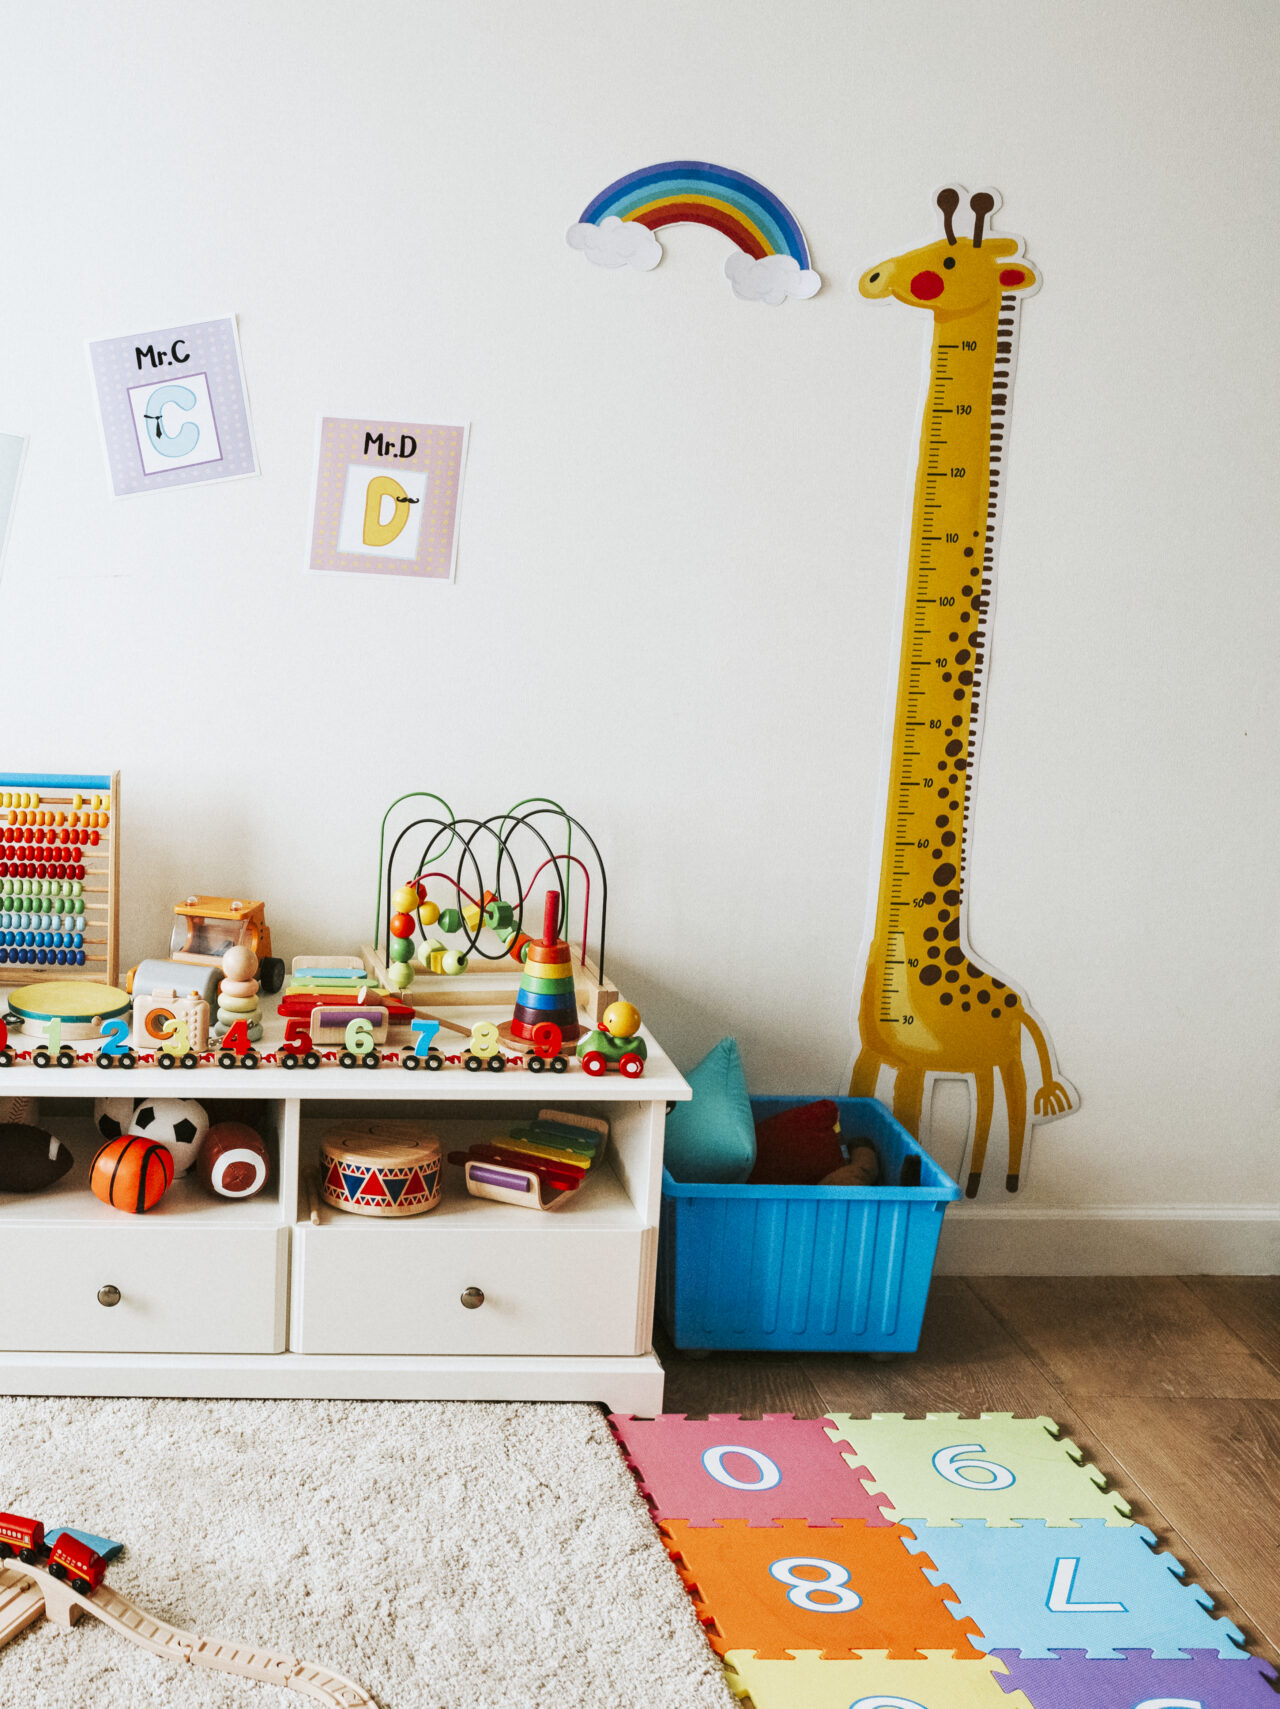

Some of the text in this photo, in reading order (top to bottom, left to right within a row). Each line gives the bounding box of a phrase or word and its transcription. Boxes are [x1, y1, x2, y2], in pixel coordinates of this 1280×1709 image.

[962, 340, 977, 352] 140
[135, 339, 191, 370] Mr.C
[956, 404, 972, 416] 130
[145, 384, 201, 458] C
[363, 431, 417, 459] Mr.D
[950, 467, 966, 478] 120
[362, 475, 411, 547] D
[946, 533, 959, 544] 110
[939, 596, 955, 607] 100
[935, 658, 948, 668] 90
[929, 719, 942, 729] 80
[923, 778, 934, 788] 70
[917, 838, 930, 849] 60
[913, 897, 925, 908] 50
[907, 958, 919, 968] 40
[902, 1015, 914, 1025] 30
[41, 1017, 62, 1055] 1
[100, 1018, 130, 1054] 2
[161, 1019, 190, 1056] 3
[222, 1019, 251, 1055] 4
[284, 1018, 313, 1055] 5
[345, 1017, 374, 1054] 6
[411, 1019, 440, 1057] 7
[470, 1020, 499, 1058] 8
[532, 1021, 562, 1058] 9
[768, 1556, 863, 1613] 8
